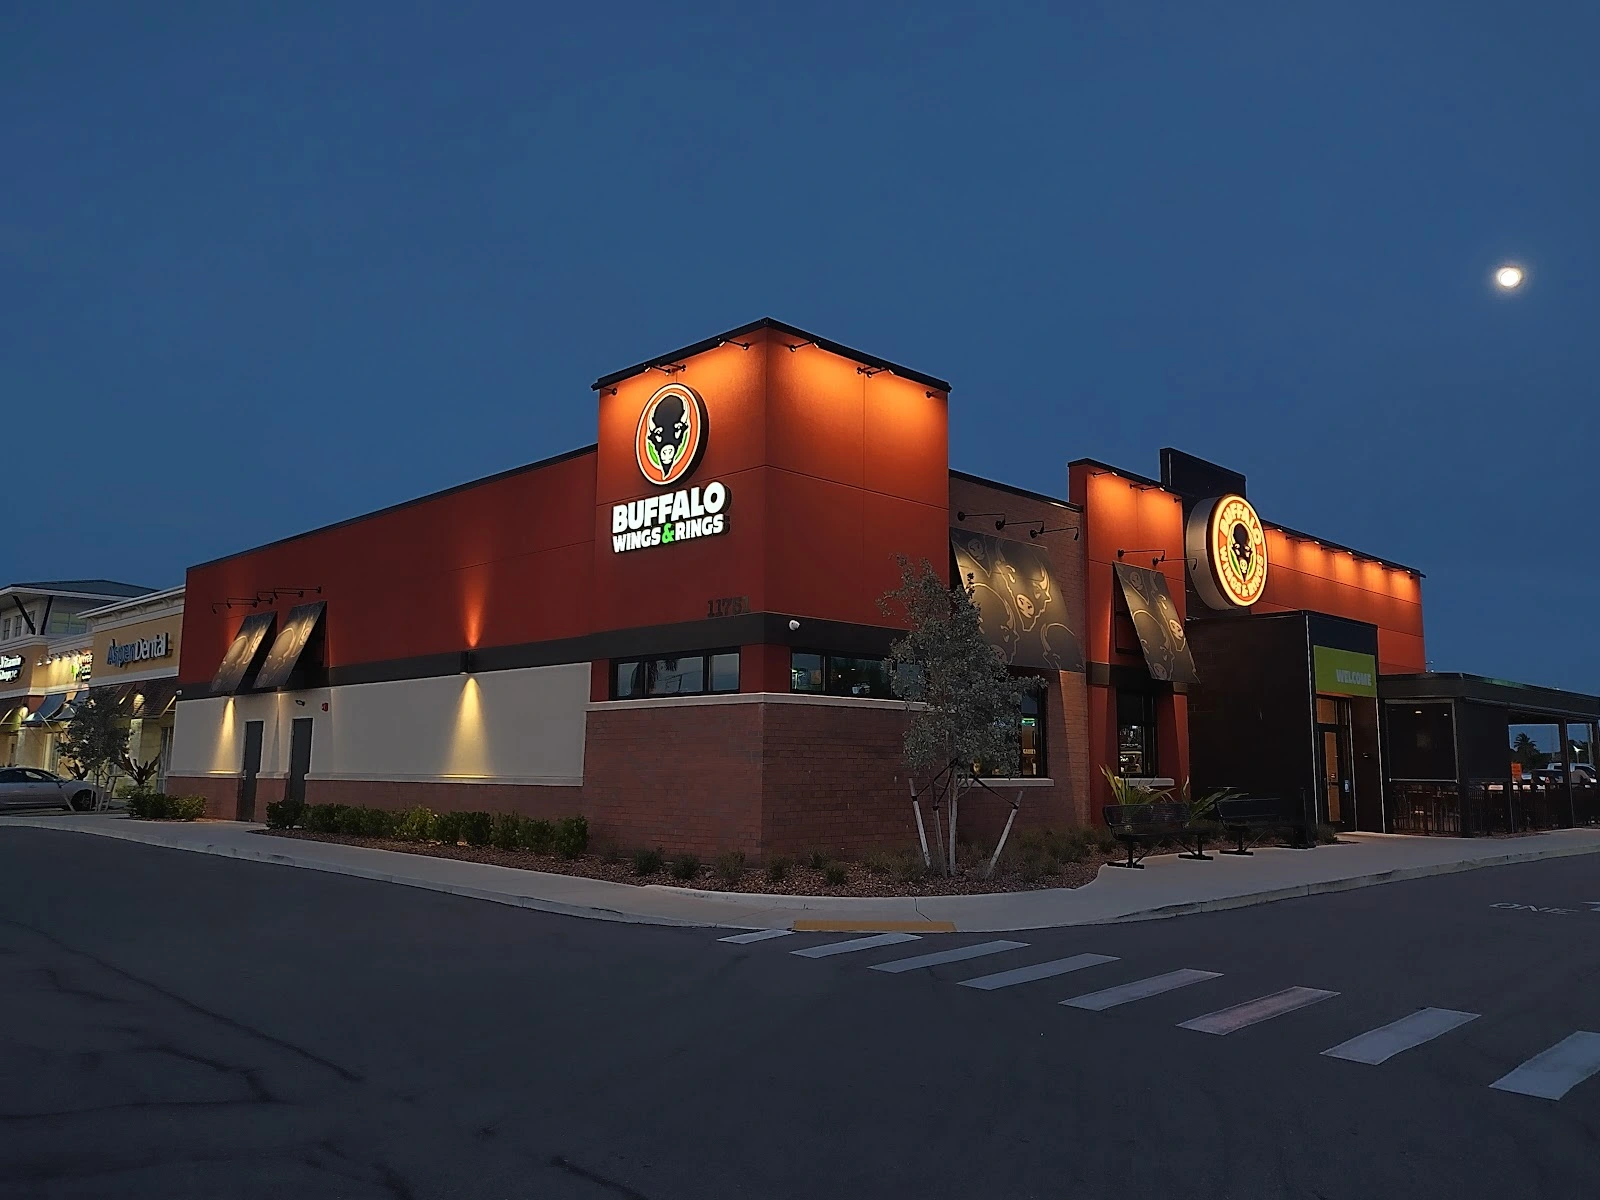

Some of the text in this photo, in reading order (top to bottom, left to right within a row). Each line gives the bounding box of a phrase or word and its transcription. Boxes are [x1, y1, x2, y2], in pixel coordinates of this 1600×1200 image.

[612, 481, 726, 534] BUFFALO
[1219, 502, 1262, 545] BUFFALO
[1335, 668, 1372, 687] WELCOME
